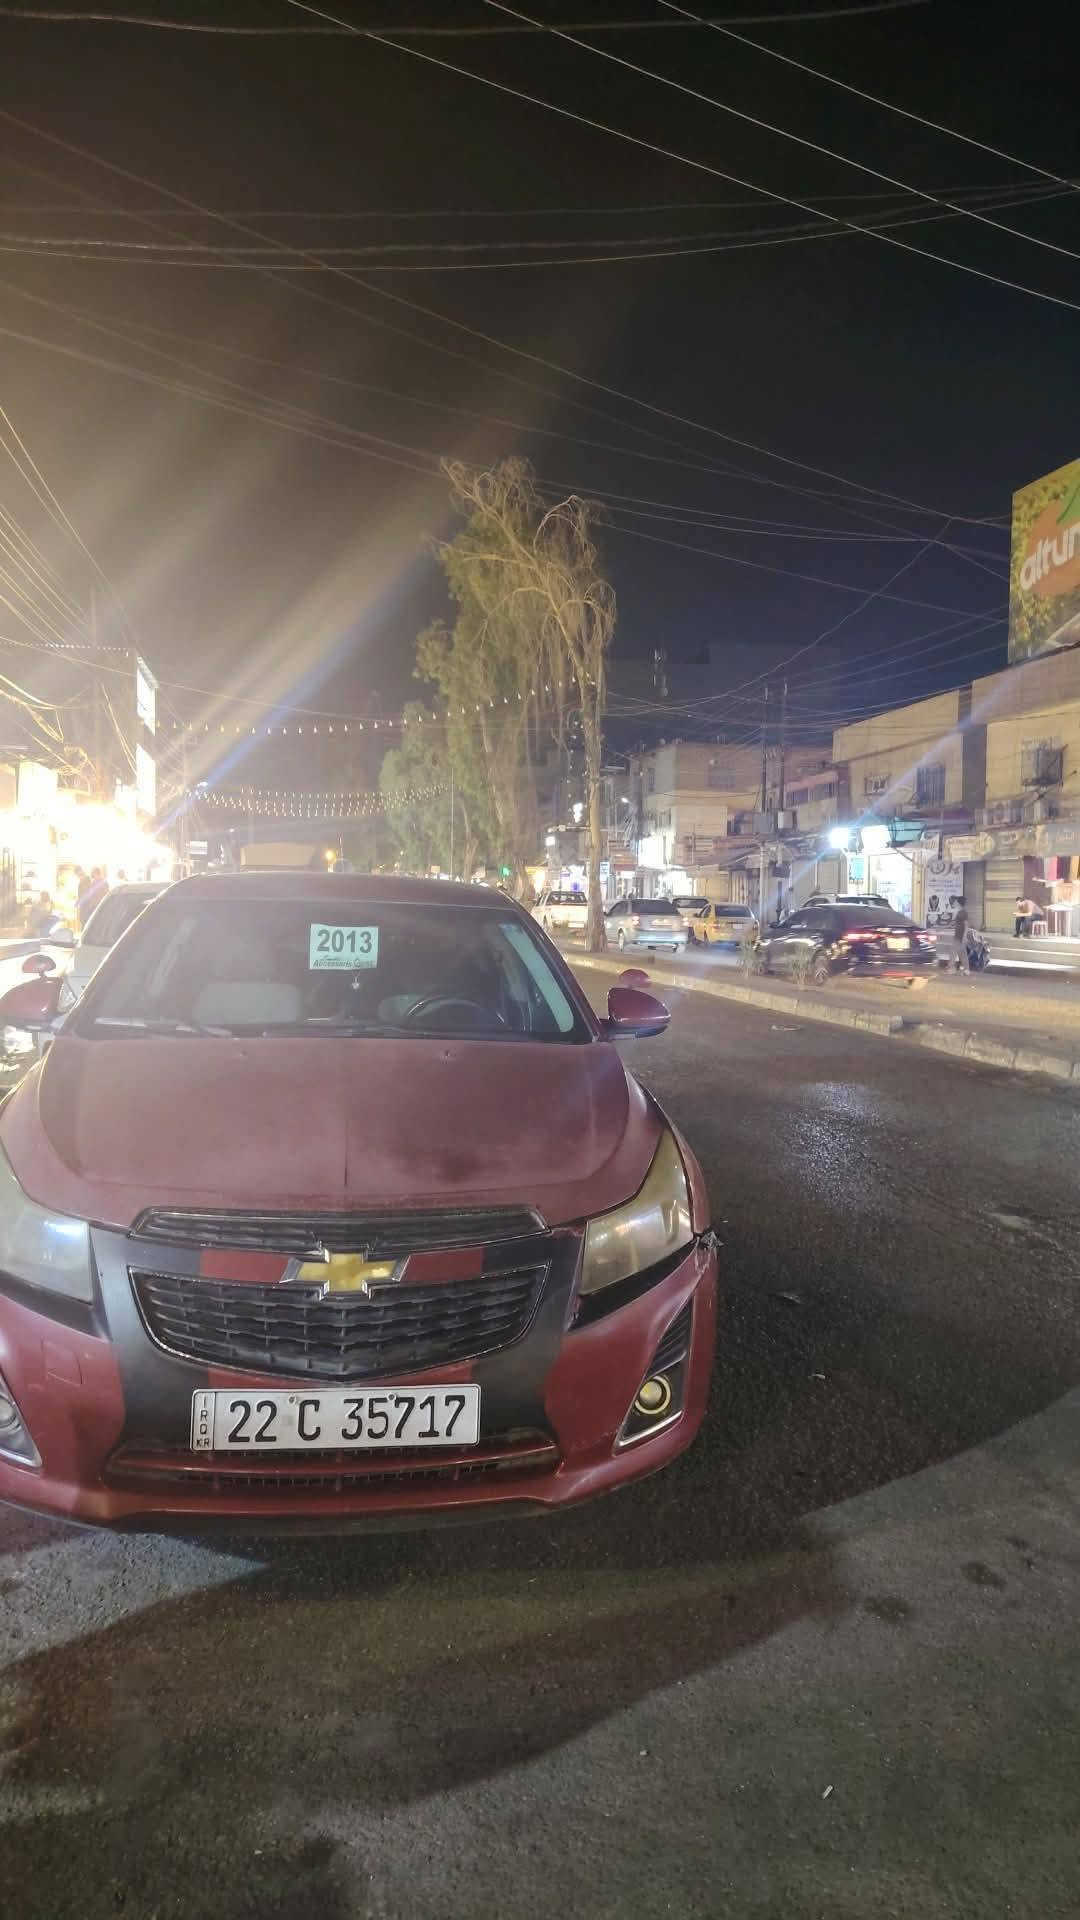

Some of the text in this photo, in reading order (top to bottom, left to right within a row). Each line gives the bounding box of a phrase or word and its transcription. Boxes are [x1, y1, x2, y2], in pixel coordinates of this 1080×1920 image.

[316, 929, 373, 953] 2013
[228, 1395, 466, 1442] 22 C 35717
